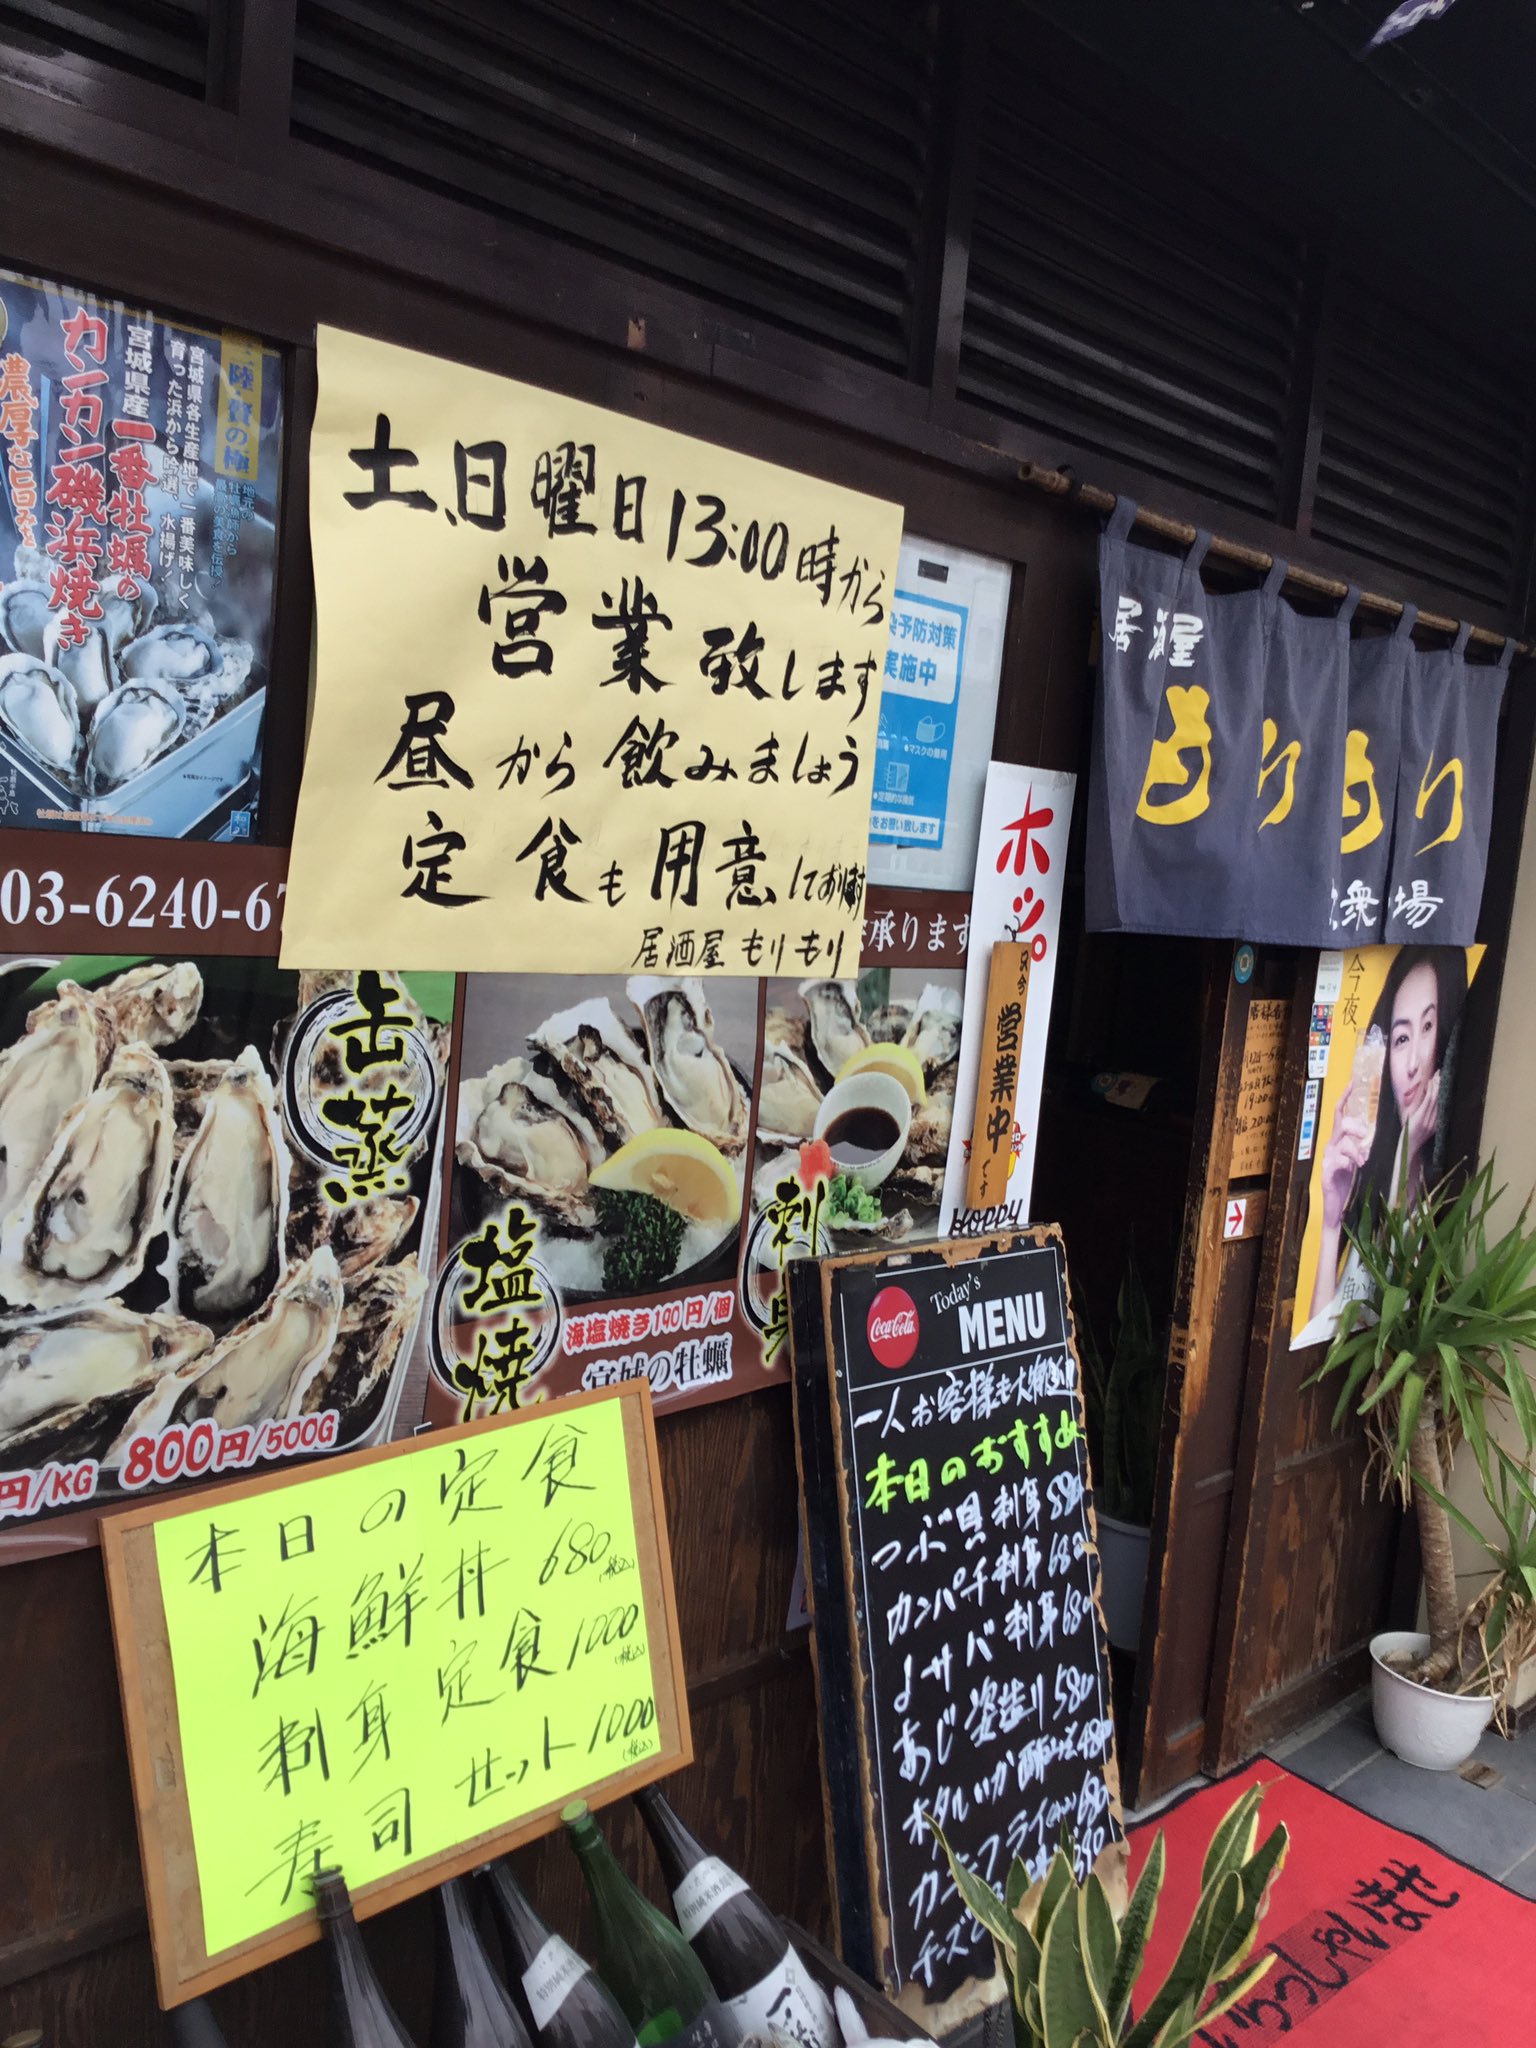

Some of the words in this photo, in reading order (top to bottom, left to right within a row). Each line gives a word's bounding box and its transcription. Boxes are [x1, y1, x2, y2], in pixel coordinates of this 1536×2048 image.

[122, 325, 153, 420] 宮城県産
[242, 484, 256, 520] 地元の
[478, 555, 878, 723] 営業致します
[374, 690, 860, 799] 昼から飲みましょう
[1136, 685, 1464, 856] もりもり
[869, 815, 937, 836] をお願い致します
[1, 868, 287, 933] 03-6240-6
[631, 927, 725, 970] 居酒屋
[741, 929, 845, 979] もりもり
[948, 1198, 1023, 1238] Hoppy
[870, 1309, 917, 1342] Coca-Cola
[930, 1273, 982, 1315] Today's
[957, 1290, 1048, 1355] MENU
[124, 1414, 337, 1486] 800円/500G
[865, 1409, 1086, 1514] 本日のおすすめ
[185, 1423, 596, 1593] 本日の定食
[252, 1541, 510, 1699] 海鮮丼
[538, 1518, 612, 1586] 680
[258, 1608, 557, 1797] 刺身定食
[566, 1603, 640, 1672] 1000
[245, 1716, 577, 1907] 寿司セット
[587, 1697, 655, 1755] 1000
